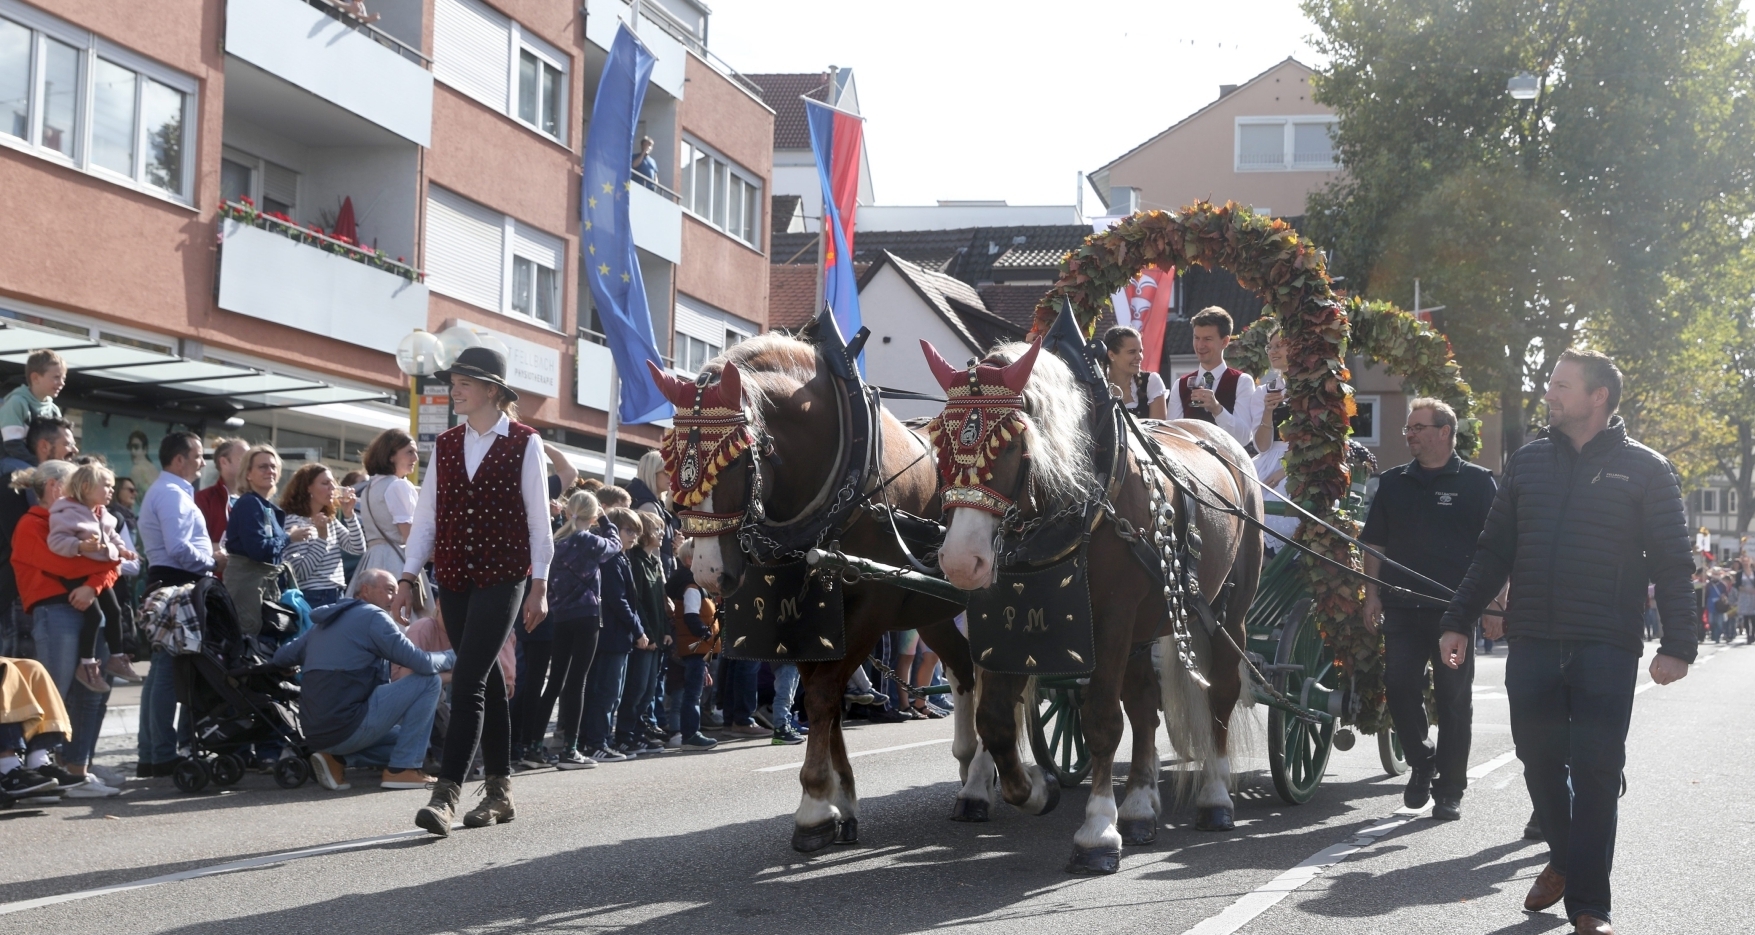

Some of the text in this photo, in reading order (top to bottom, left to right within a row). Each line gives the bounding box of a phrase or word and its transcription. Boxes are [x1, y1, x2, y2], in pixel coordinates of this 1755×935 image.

[514, 348, 555, 372] FELLBACH
[514, 367, 554, 387] PHYSIOTHERAPIE
[776, 596, 803, 623] M
[1022, 607, 1050, 632] M
